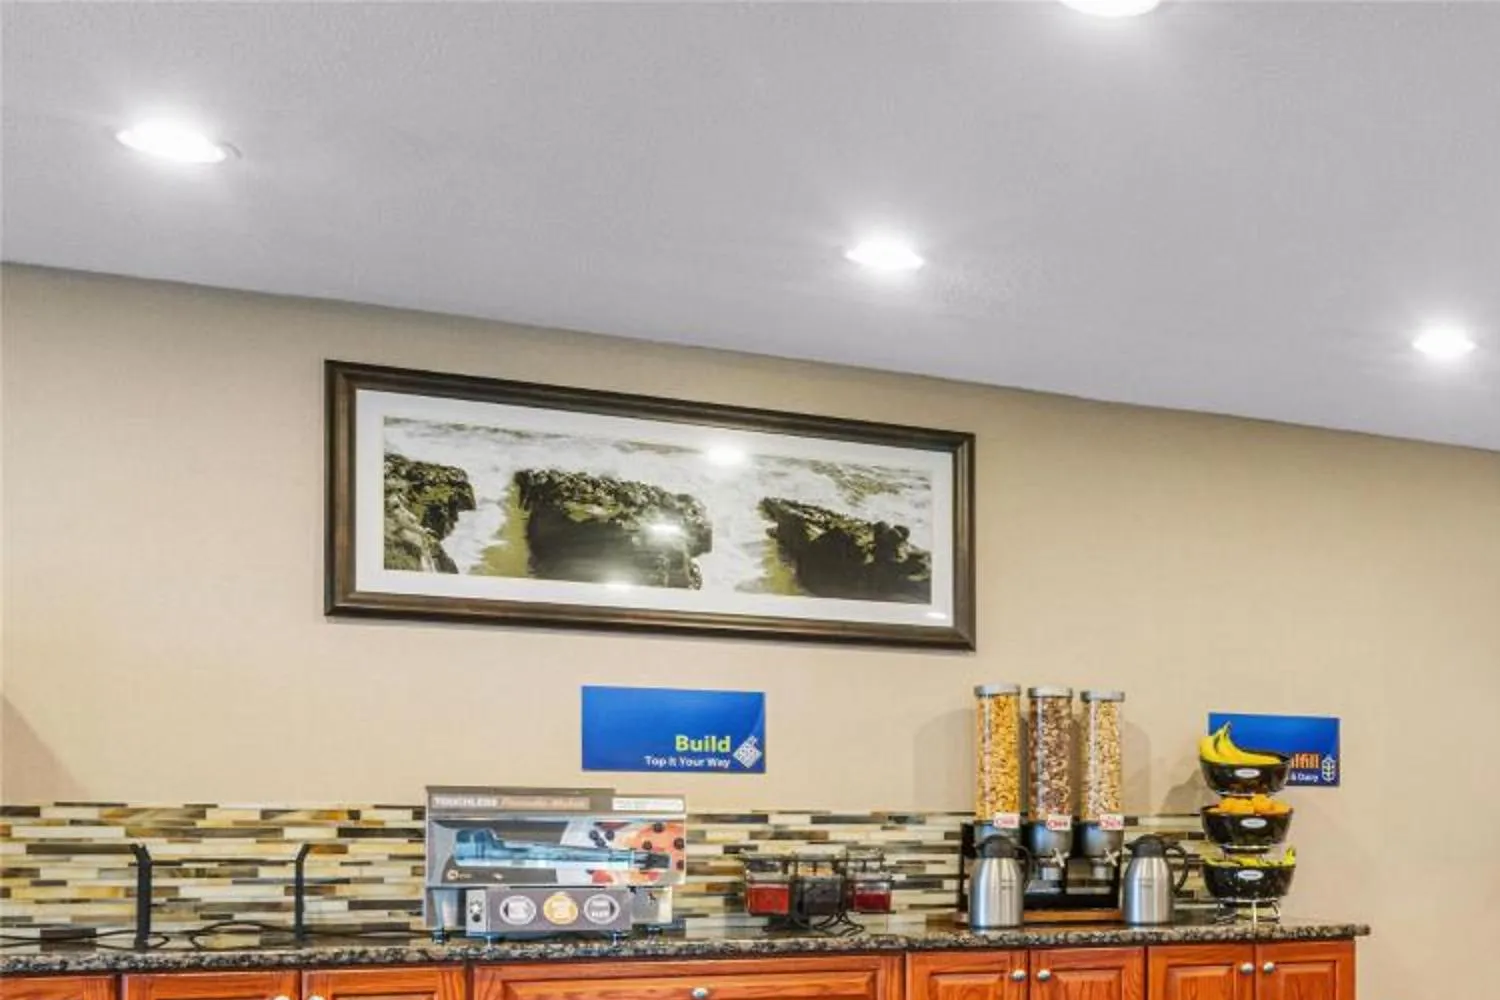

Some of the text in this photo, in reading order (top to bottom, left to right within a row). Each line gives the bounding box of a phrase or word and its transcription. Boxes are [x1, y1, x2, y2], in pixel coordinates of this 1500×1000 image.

[675, 735, 731, 752] Build
[644, 755, 667, 769] Top
[679, 757, 704, 768] Your
[707, 758, 731, 769] Way
[1290, 753, 1319, 769] lfill
